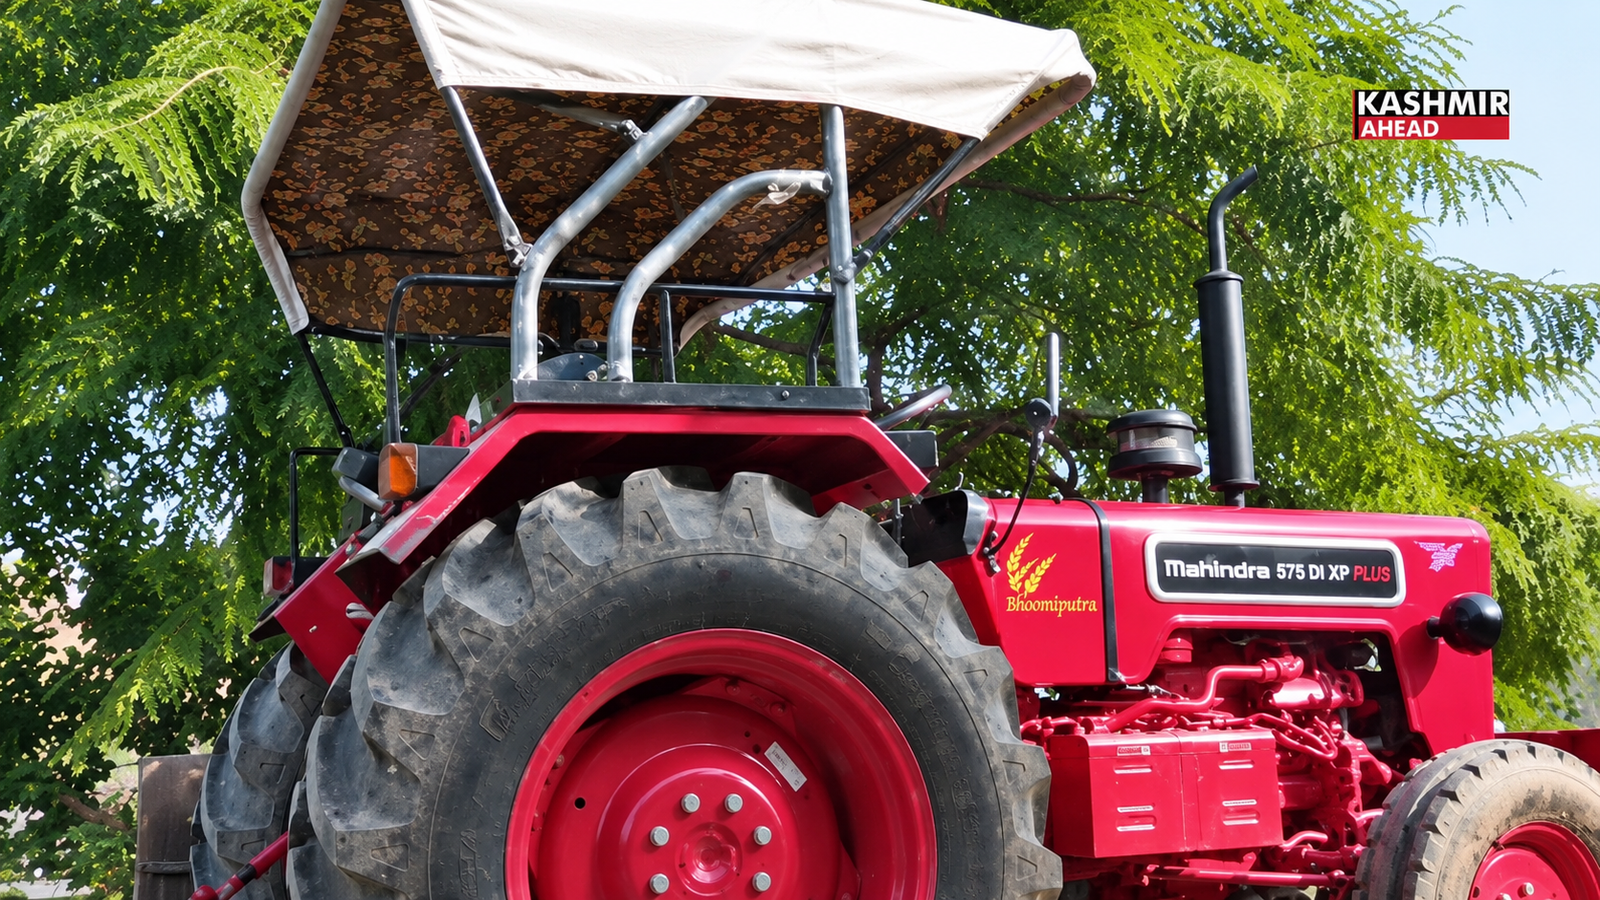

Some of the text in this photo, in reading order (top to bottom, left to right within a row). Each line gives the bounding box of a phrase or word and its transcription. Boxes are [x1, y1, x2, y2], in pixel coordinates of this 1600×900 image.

[1164, 559, 1391, 582] Mahindra 575 DI XP PLUS
[1006, 593, 1098, 618] Bhoomiputra
